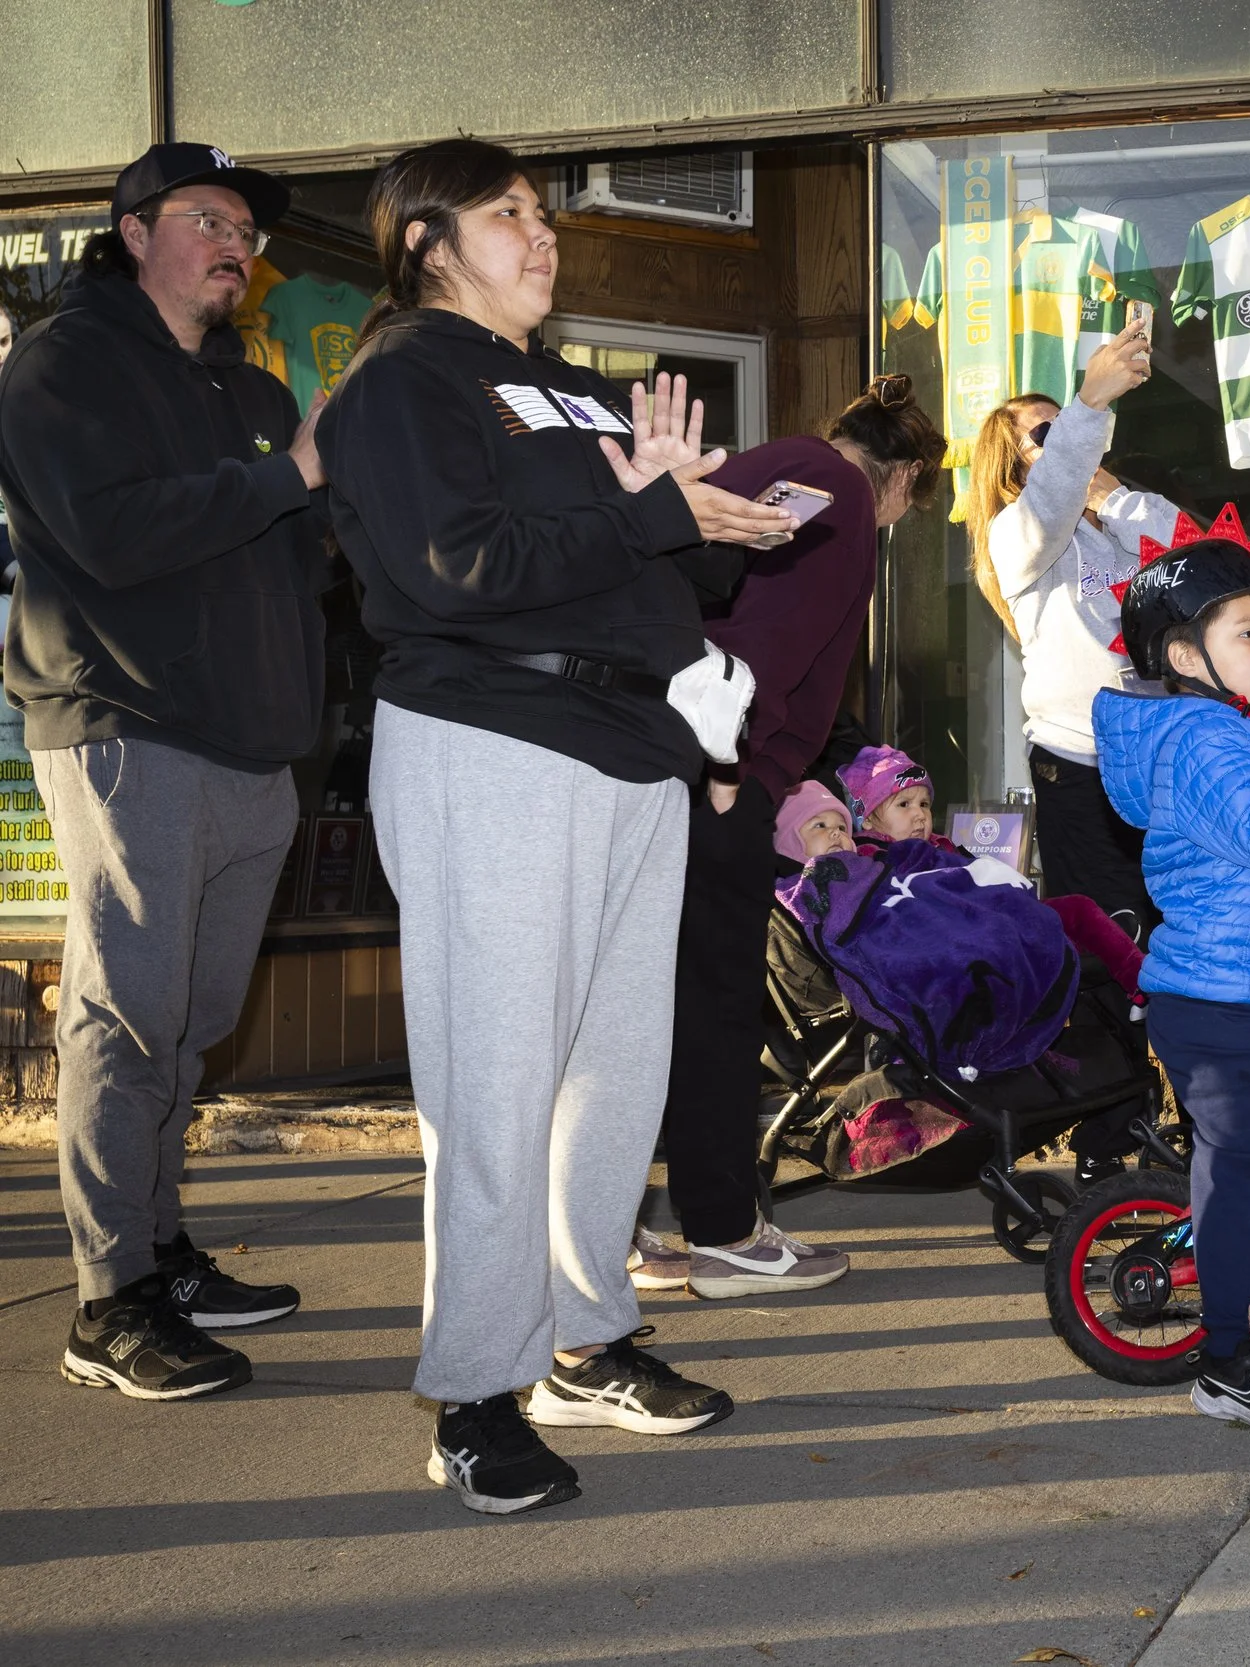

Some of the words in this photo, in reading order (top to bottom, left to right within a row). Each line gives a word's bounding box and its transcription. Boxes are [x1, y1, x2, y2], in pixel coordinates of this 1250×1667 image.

[0, 232, 49, 271] VEL
[61, 226, 112, 262] TE
[964, 255, 991, 346] CLUB
[1081, 297, 1101, 309] ker
[13, 791, 35, 811] turf
[0, 820, 21, 841] her
[6, 849, 24, 871] for
[27, 852, 55, 872] ages
[6, 879, 34, 901] staff
[37, 880, 49, 901] at
